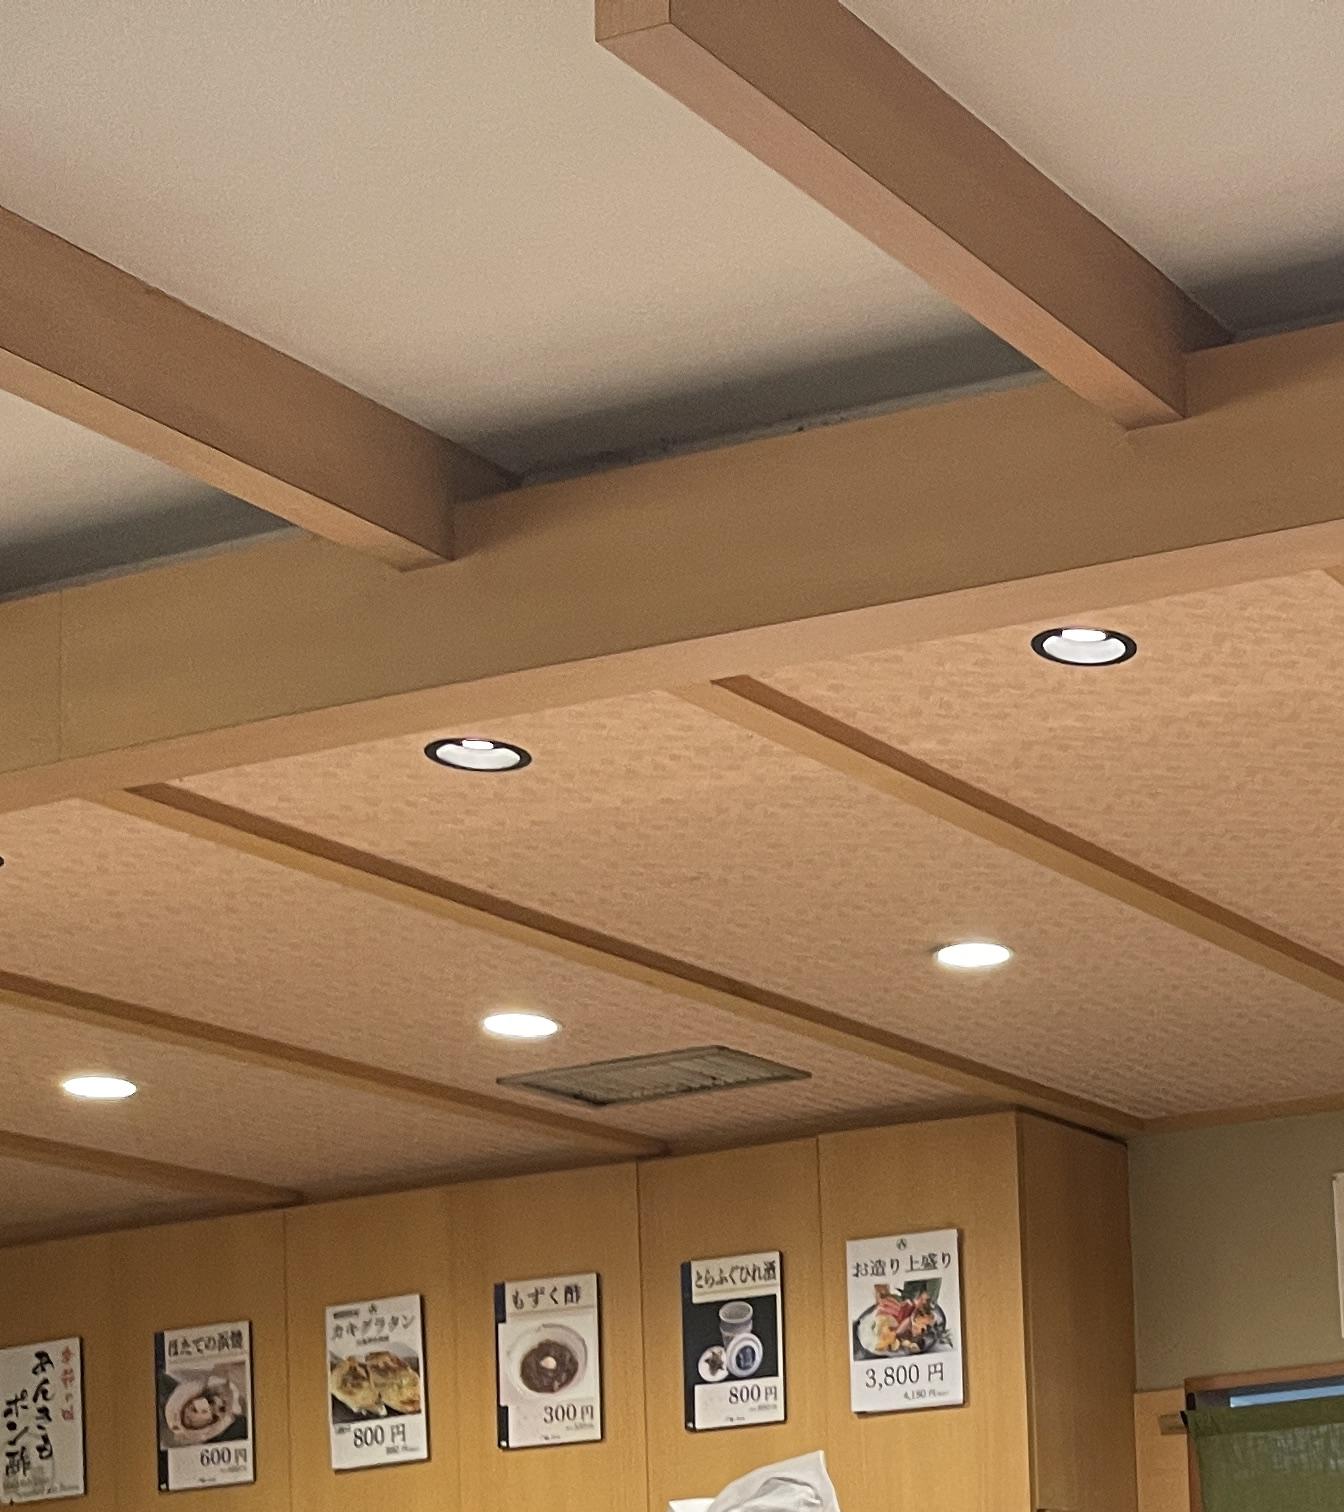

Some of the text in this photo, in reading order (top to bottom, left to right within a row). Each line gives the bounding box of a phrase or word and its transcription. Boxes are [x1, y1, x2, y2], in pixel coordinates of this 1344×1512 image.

[695, 1260, 777, 1289] とらふぐひれ酒
[512, 1284, 581, 1310] もずく酢
[729, 1384, 778, 1404] 800円
[4, 1389, 30, 1477] ポン酢
